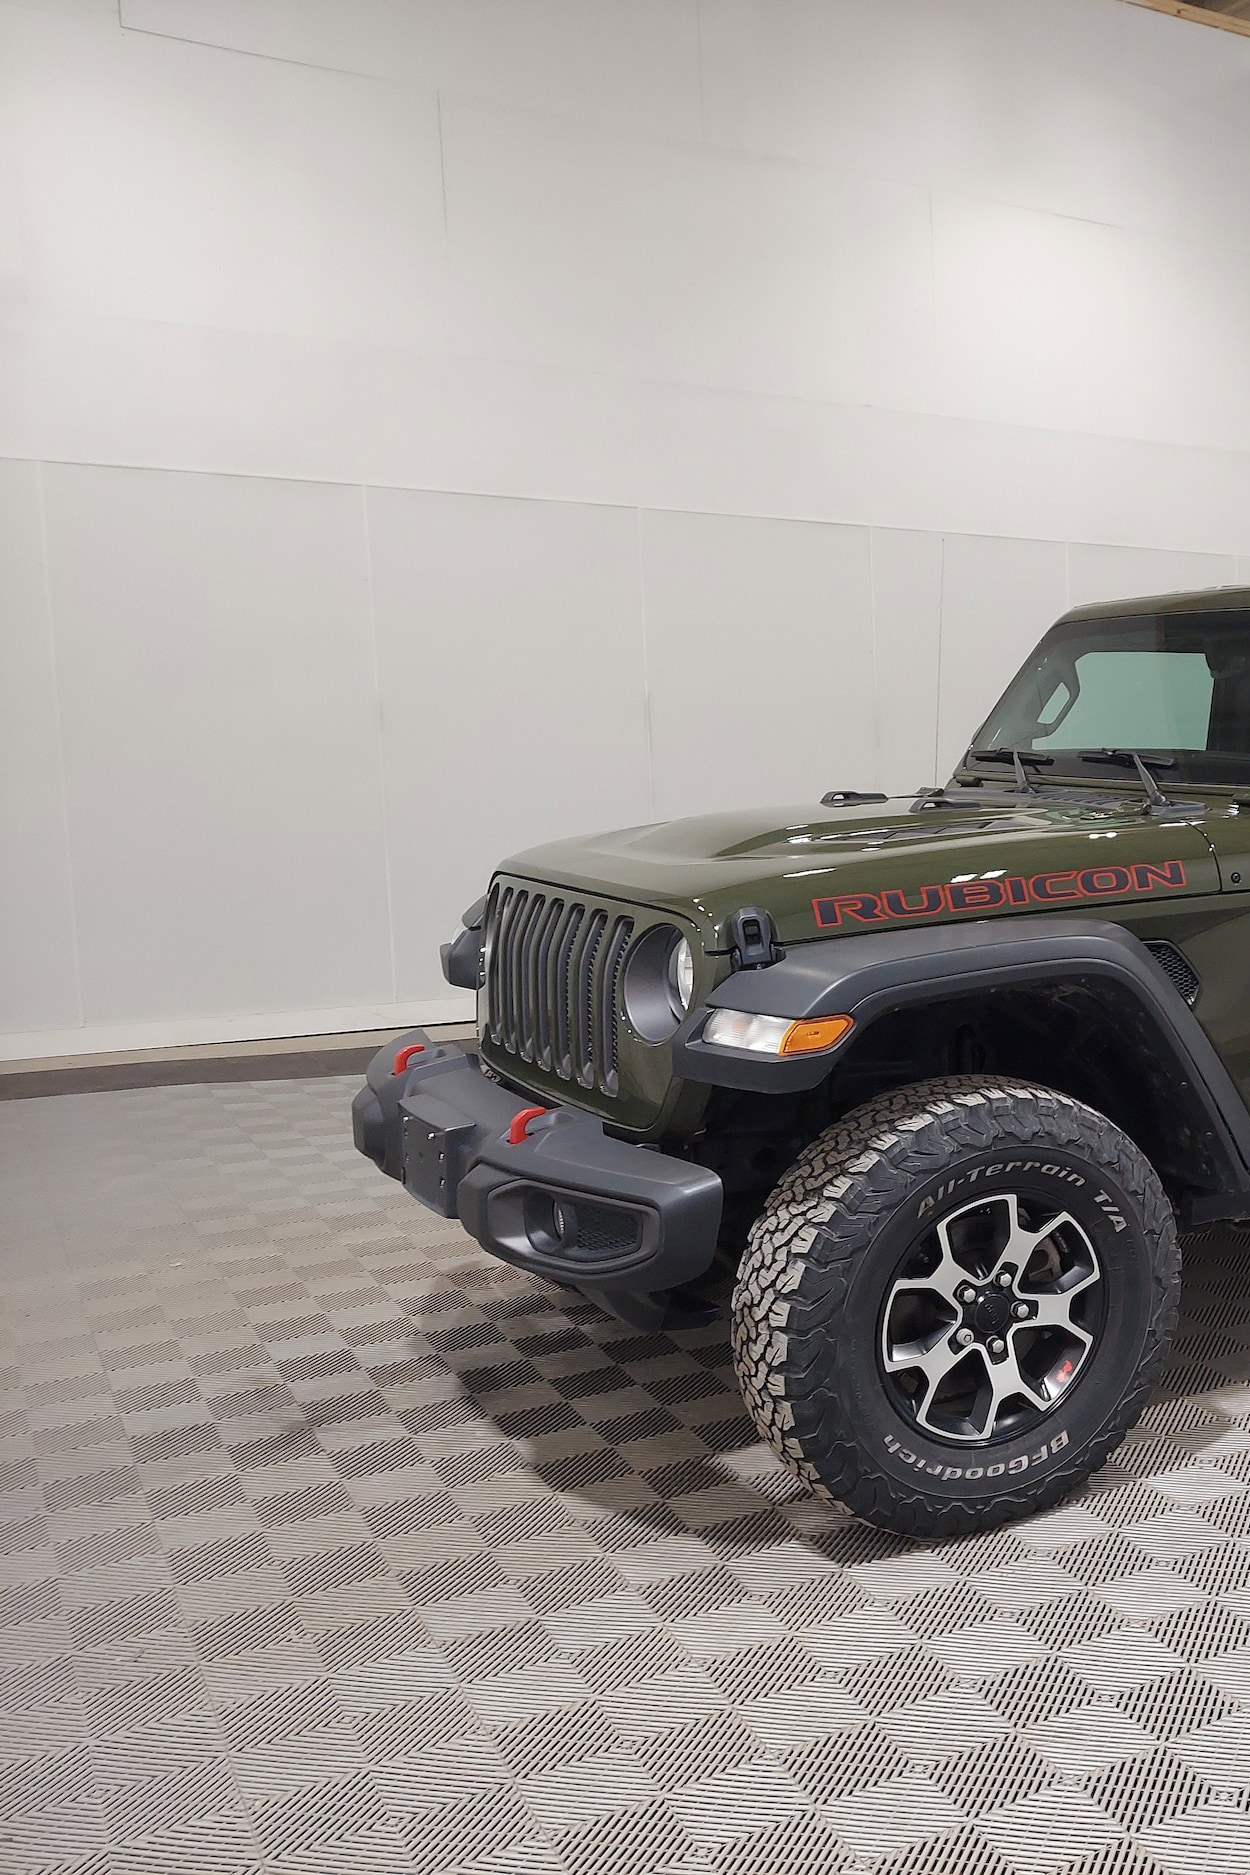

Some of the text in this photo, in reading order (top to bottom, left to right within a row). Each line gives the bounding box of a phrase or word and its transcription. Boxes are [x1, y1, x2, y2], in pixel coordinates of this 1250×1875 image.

[811, 860, 1187, 928] RUBICON
[917, 1161, 1128, 1233] All-Terrain T/A
[883, 1430, 1071, 1481] BFGoodrich
